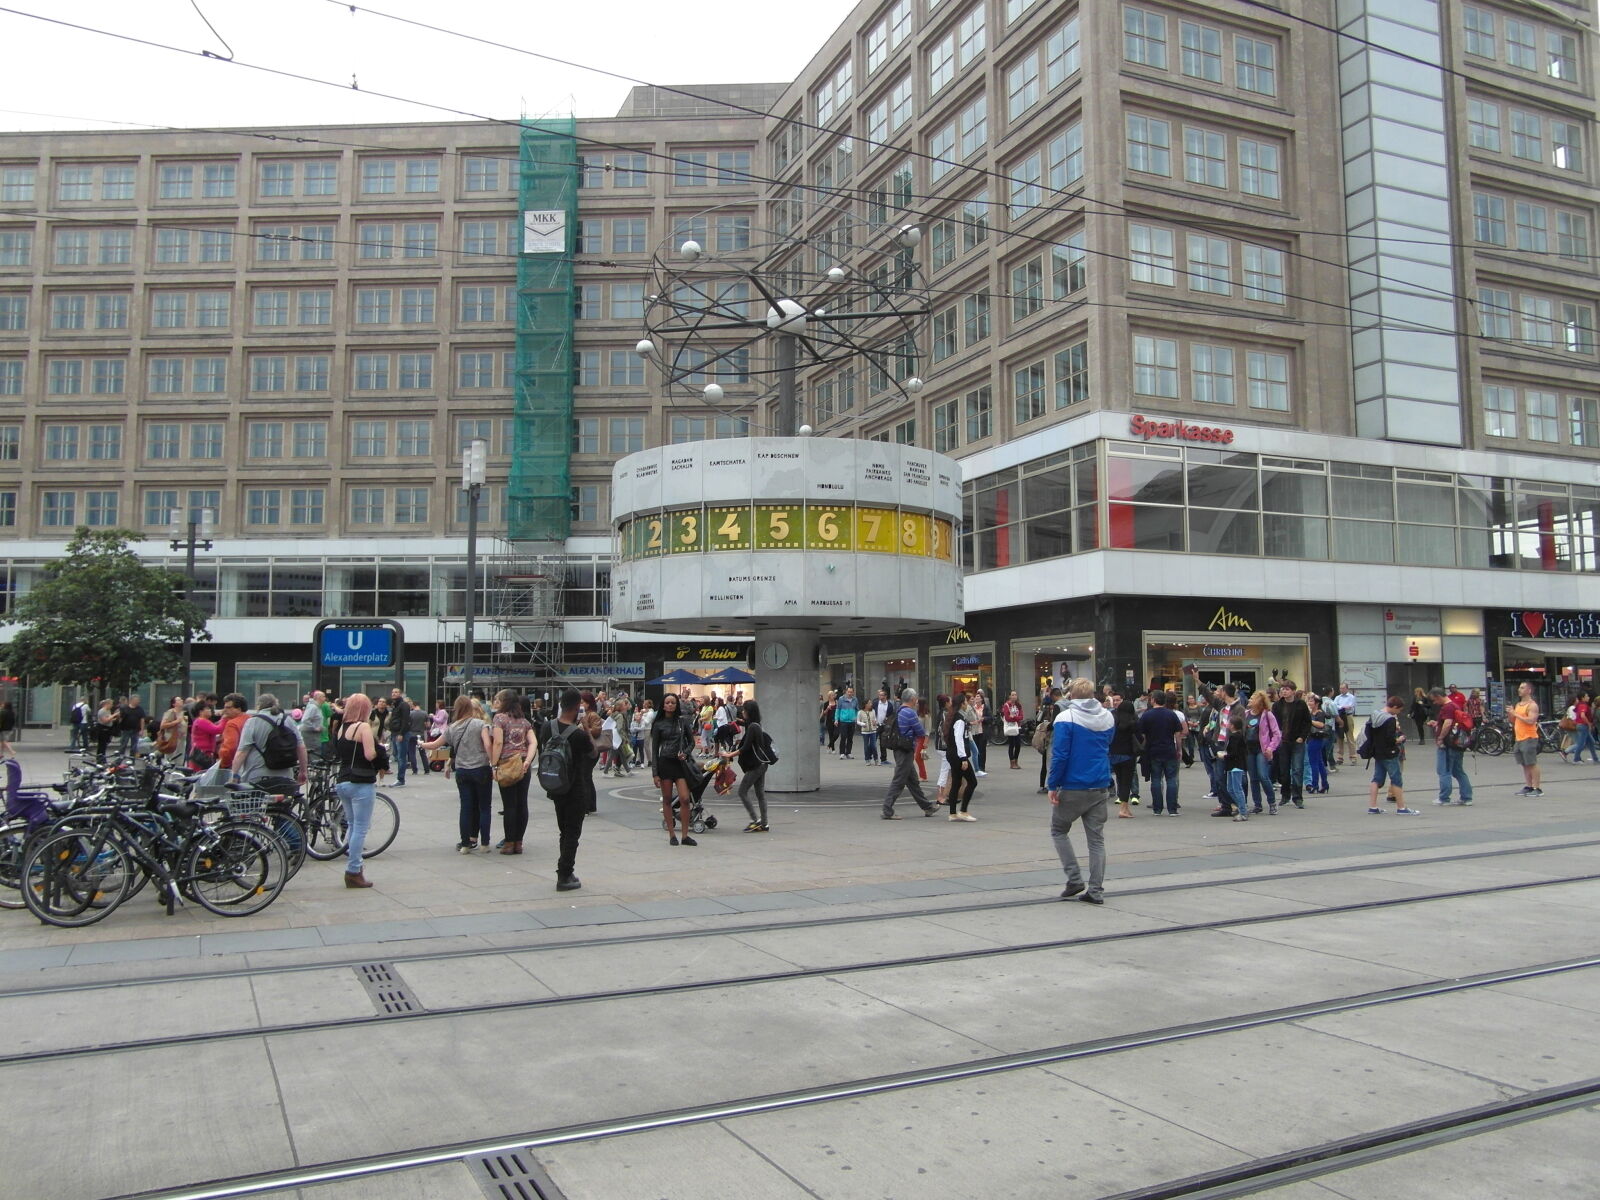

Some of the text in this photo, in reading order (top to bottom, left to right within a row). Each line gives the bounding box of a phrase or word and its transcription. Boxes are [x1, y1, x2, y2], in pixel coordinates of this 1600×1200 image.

[533, 213, 557, 223] MKK
[1130, 414, 1234, 444] Sparkasse
[709, 459, 746, 467] KAMTSCHATKA
[864, 474, 893, 482] ANCHORAGE
[648, 520, 662, 548] 2
[681, 516, 697, 544] 3
[718, 513, 741, 540] 4
[769, 512, 790, 540] 5
[818, 512, 839, 541] 6
[862, 515, 881, 542] 7
[903, 519, 917, 547] 8
[1208, 606, 1253, 632] Ann
[347, 630, 363, 650] U
[324, 652, 388, 663] Alexanderplatz
[699, 648, 738, 659] Tchibo
[569, 666, 644, 677] ALEXANDERHAUS
